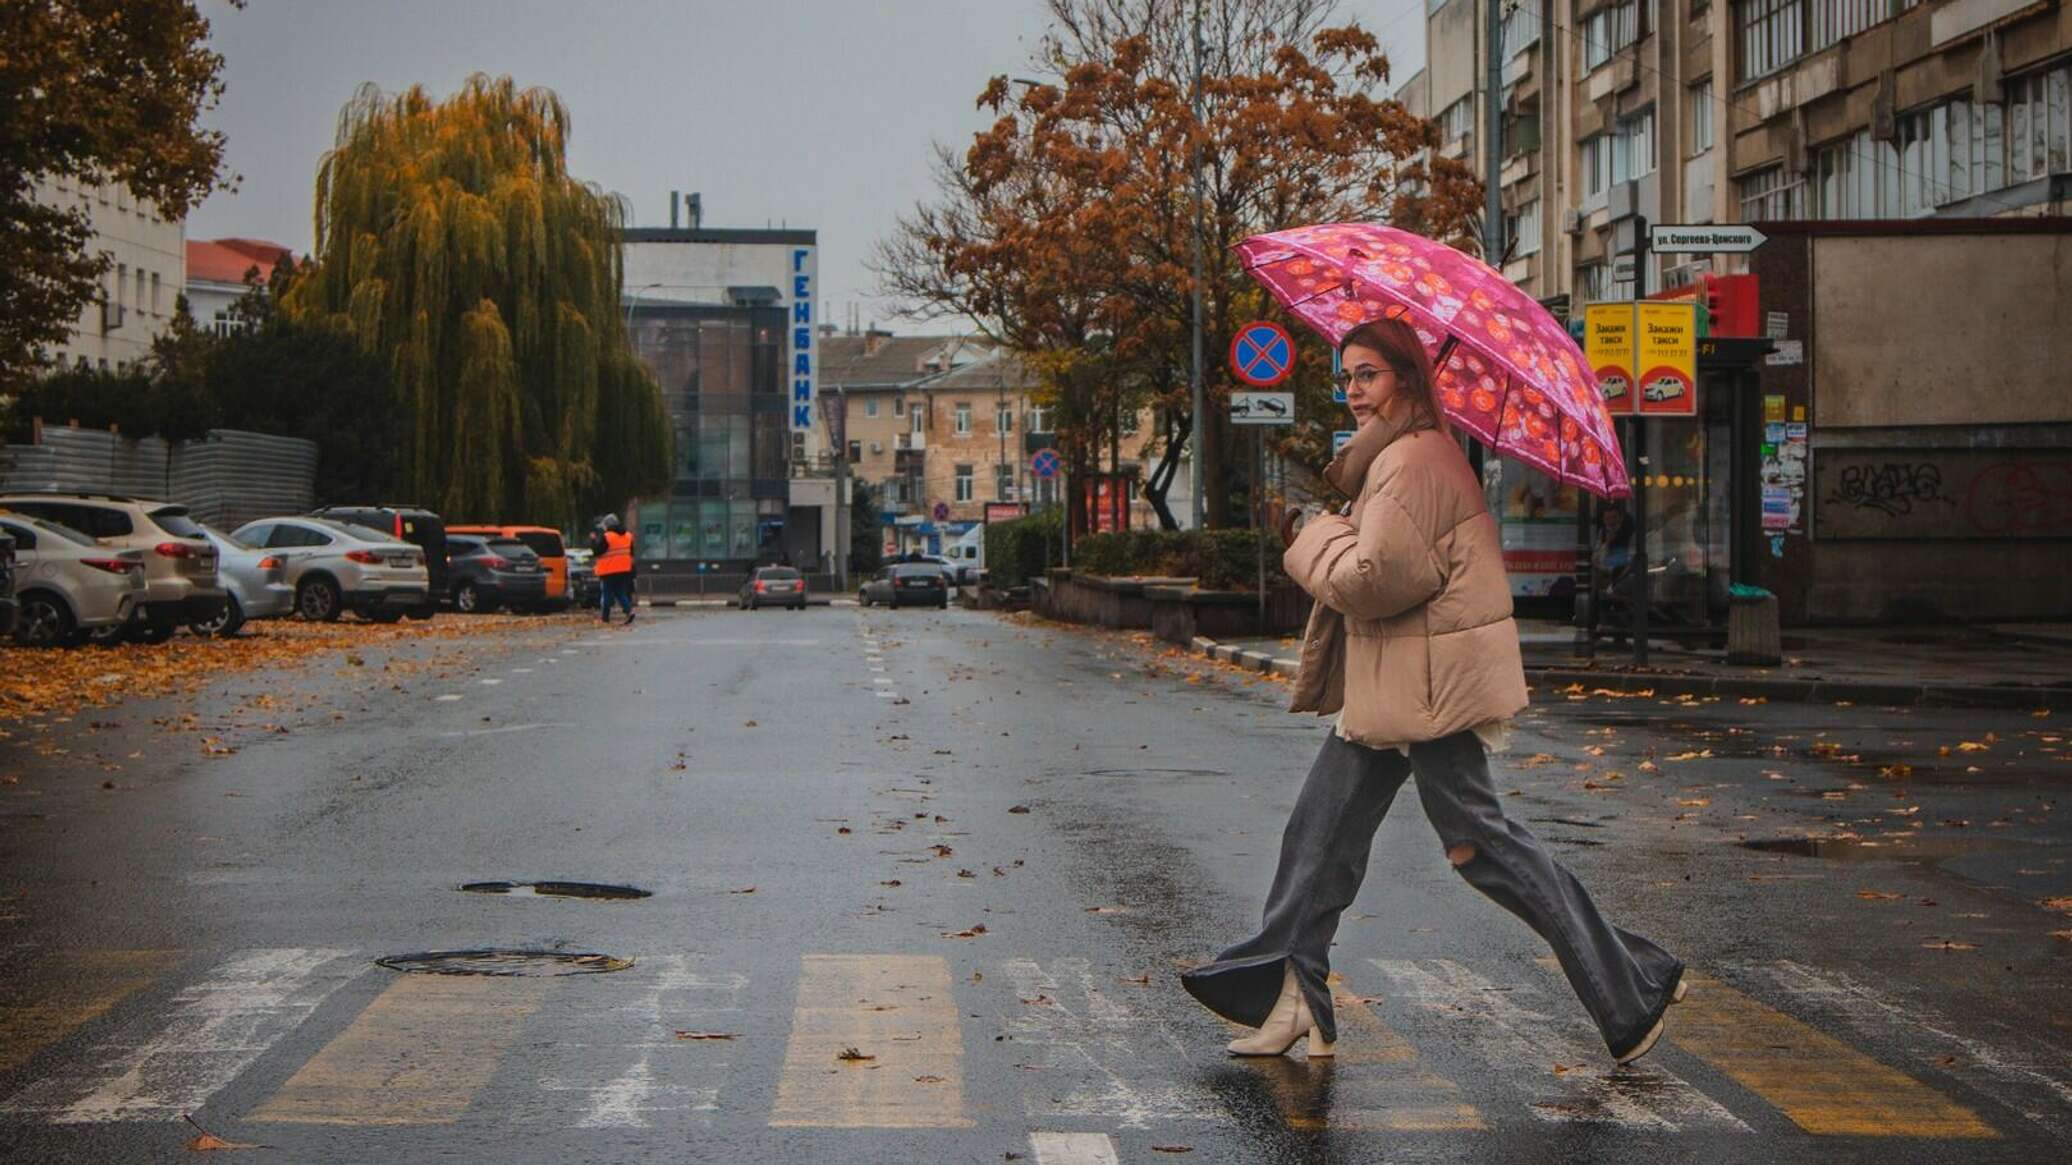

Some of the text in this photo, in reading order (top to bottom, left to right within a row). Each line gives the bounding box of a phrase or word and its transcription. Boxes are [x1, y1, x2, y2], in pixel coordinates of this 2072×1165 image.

[1595, 323, 1626, 334] Закажи
[1647, 322, 1684, 334] Закажи
[794, 249, 810, 427] ГЕНБАНК
[1600, 336, 1623, 345] такси
[1652, 337, 1679, 345] такси
